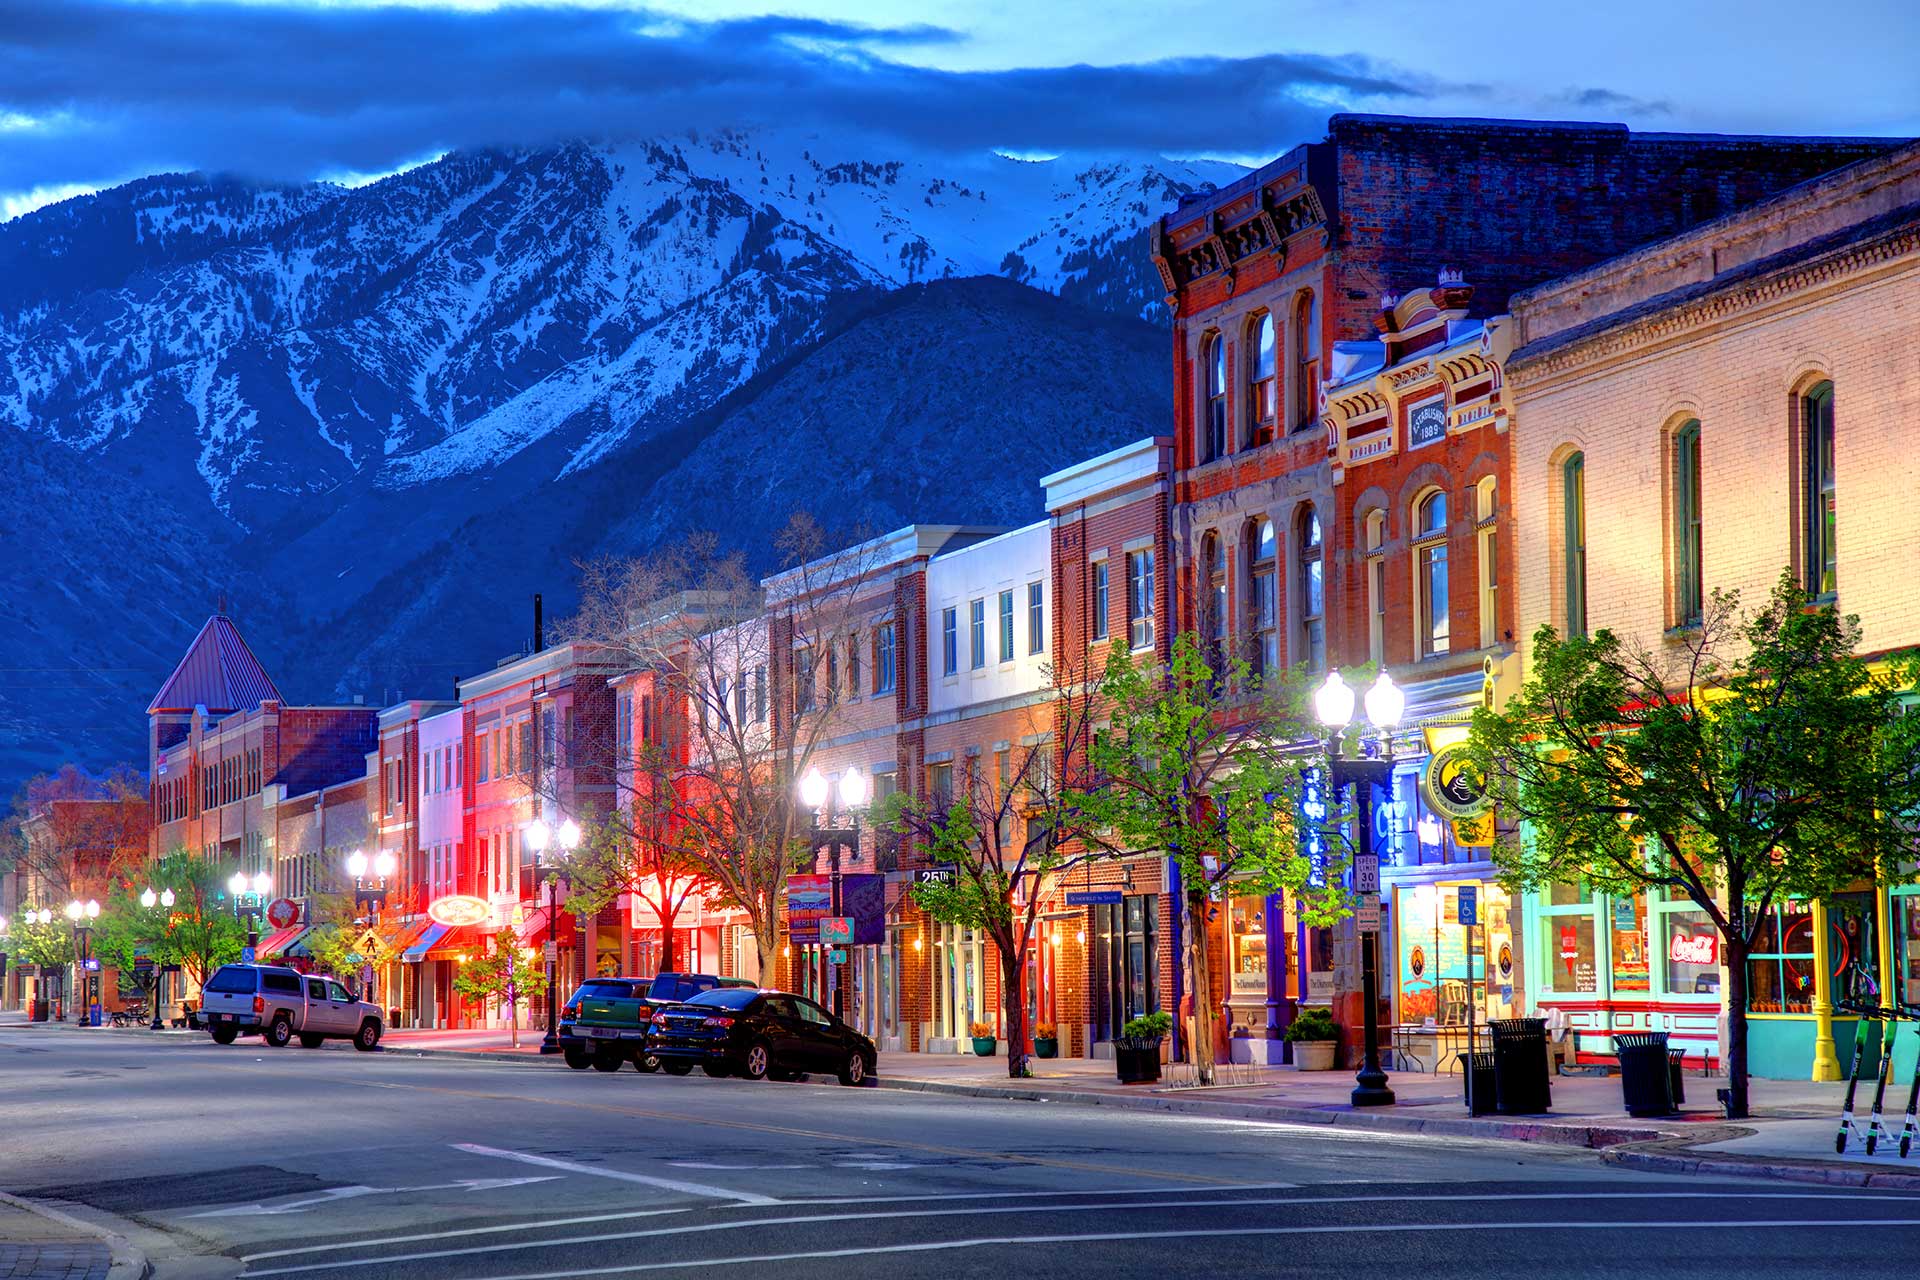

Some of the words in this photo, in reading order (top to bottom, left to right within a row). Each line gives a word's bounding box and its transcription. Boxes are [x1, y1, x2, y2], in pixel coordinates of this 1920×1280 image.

[1413, 408, 1445, 434] ESTABLISHED
[1421, 424, 1438, 440] 1889
[1432, 750, 1456, 795] GROUND
[1358, 857, 1376, 865] SPEED
[1361, 872, 1375, 883] 30
[793, 919, 819, 927] HERITA
